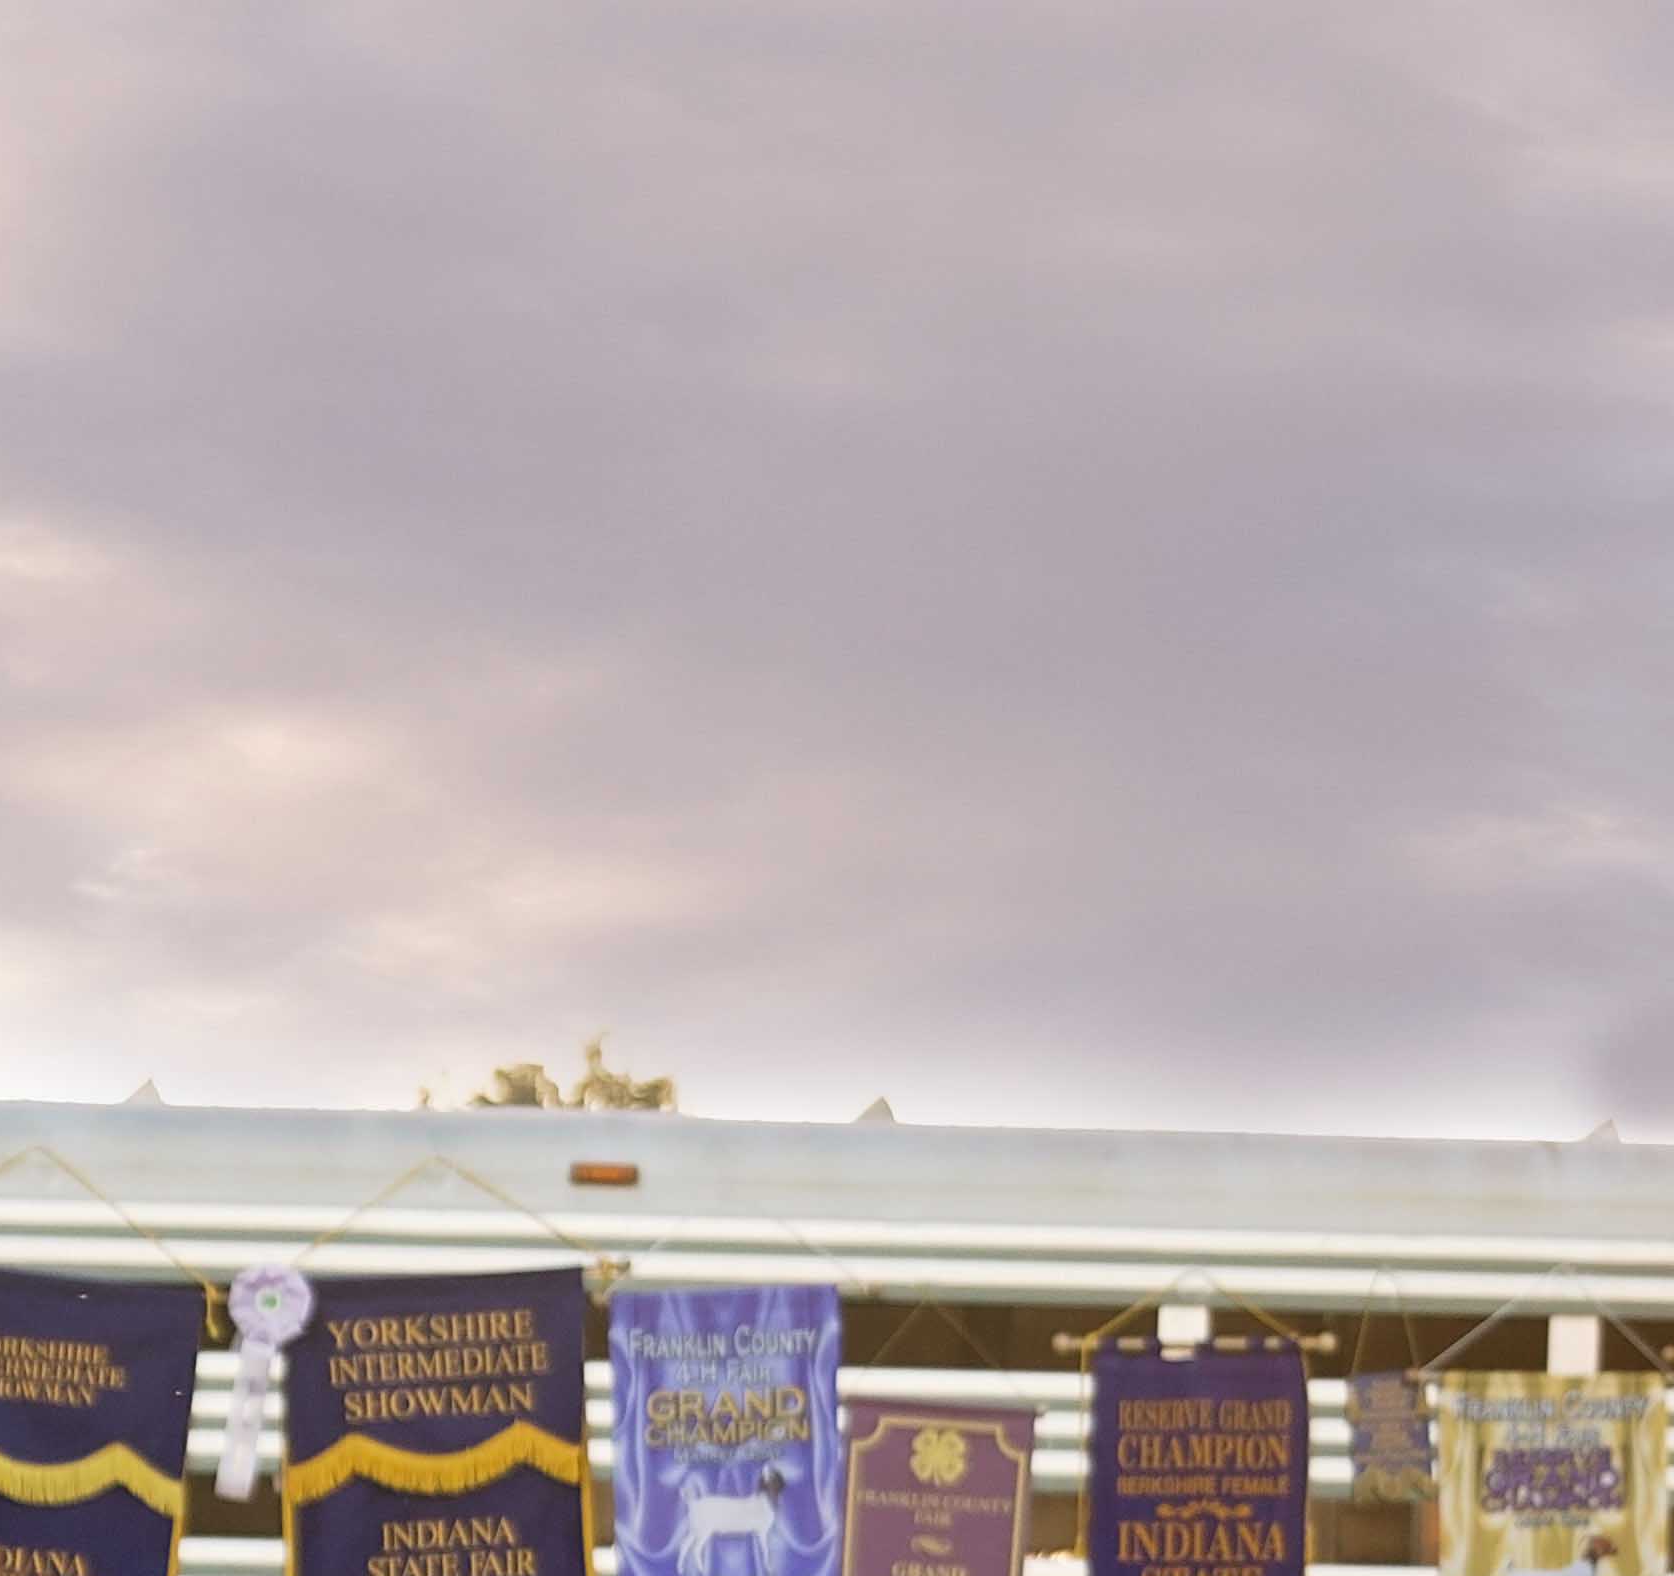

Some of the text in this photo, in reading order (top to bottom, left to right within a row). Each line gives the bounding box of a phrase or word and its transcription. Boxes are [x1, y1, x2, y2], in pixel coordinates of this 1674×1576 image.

[328, 1310, 534, 1349] YORKSHIRE
[628, 1324, 817, 1359] FRANKLIN COUNTY
[328, 1342, 548, 1386] INTERMEDIATE
[344, 1383, 536, 1422] SHOWMAN
[646, 1384, 806, 1422] GRAND
[1118, 1400, 1291, 1431] RESERVE GRAND
[645, 1418, 811, 1446] CHAMPION
[1117, 1434, 1290, 1470] CHAMPION
[382, 1516, 515, 1552] INDIANA
[1117, 1521, 1286, 1561] INDIANA
